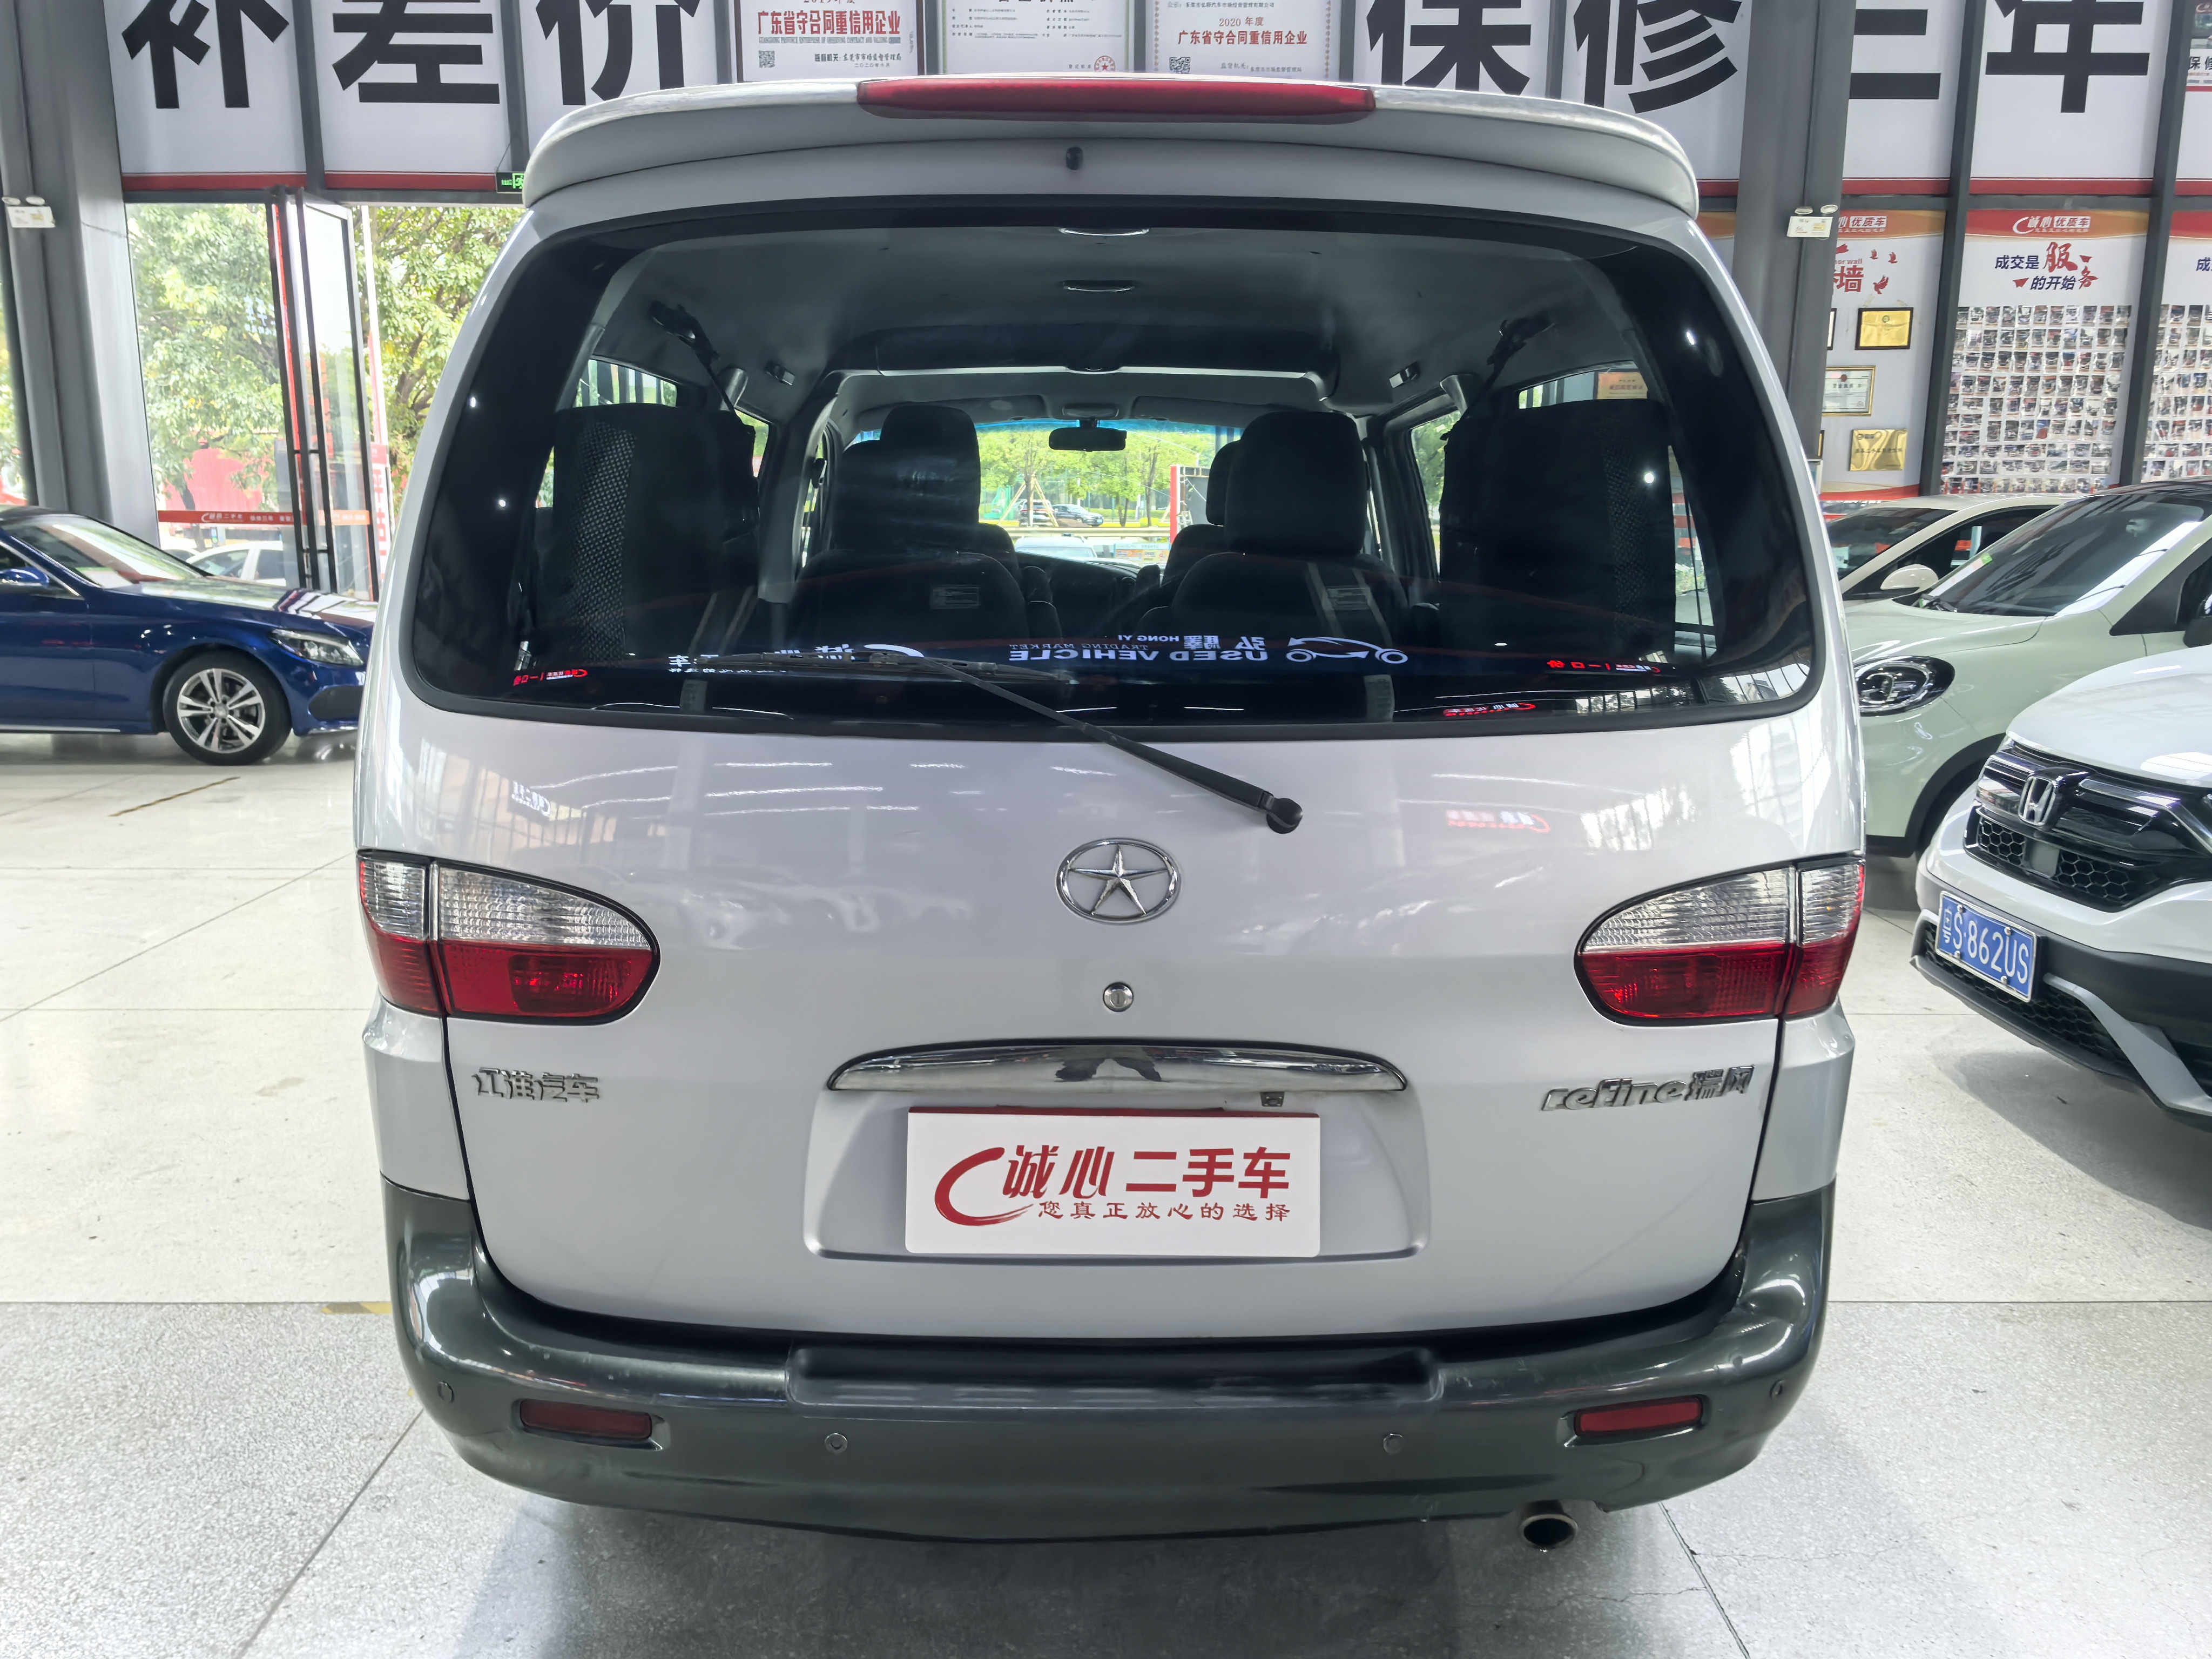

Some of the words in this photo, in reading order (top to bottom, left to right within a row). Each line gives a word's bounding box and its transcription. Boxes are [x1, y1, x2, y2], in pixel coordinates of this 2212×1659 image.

[758, 10, 901, 35] 广东省守合同重信用企业
[1219, 18, 1241, 27] 2020
[1245, 17, 1264, 26] 年度
[1178, 30, 1307, 45] 广东省守合同重信用企业
[1995, 255, 2040, 269] 成交是
[1834, 265, 1864, 293] 墙
[2029, 275, 2077, 290] 的开始
[1541, 1078, 1687, 1111] refine
[1002, 1144, 1291, 1199] 诚心二手车
[1038, 1201, 1291, 1222] 您真正放心的选择
